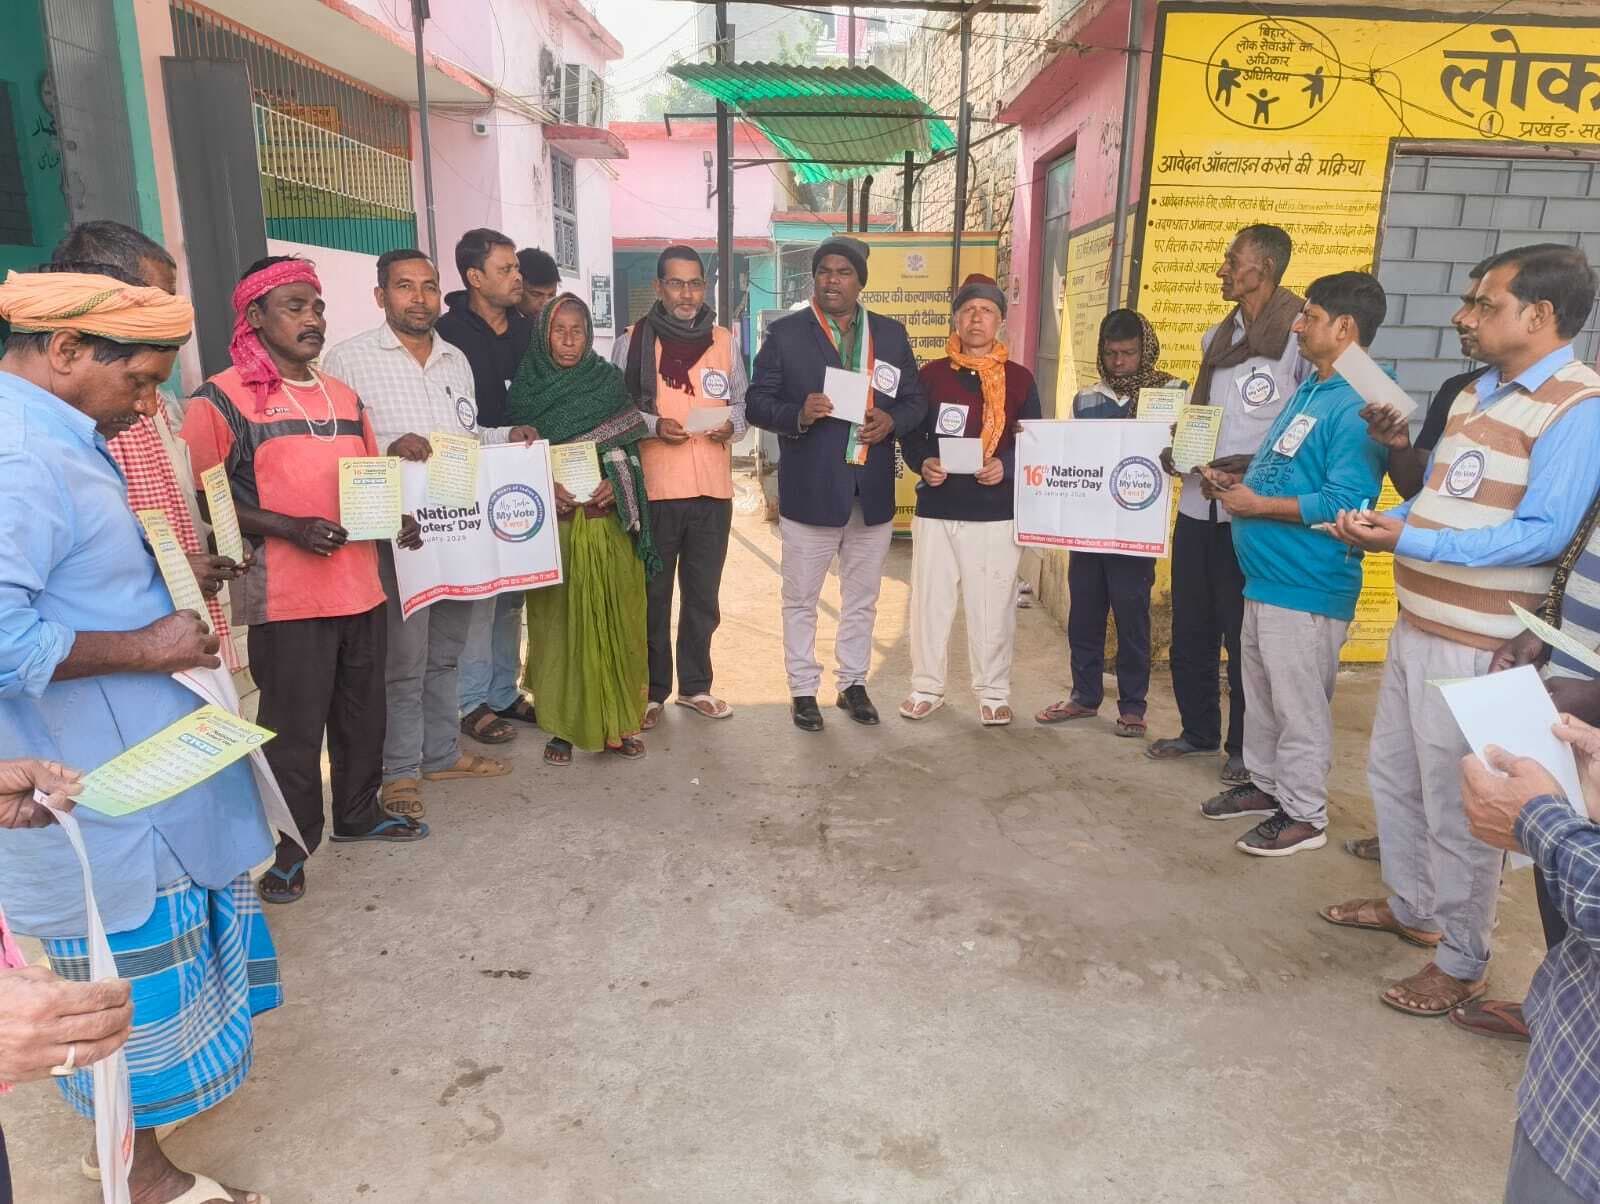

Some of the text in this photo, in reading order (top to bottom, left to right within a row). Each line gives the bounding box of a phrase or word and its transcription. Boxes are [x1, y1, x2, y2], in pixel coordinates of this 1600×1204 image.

[1258, 23, 1288, 38] बिहार
[1236, 37, 1258, 54] लोक
[1259, 38, 1297, 53] सेवाओं
[1246, 52, 1291, 68] अधिकार
[1242, 66, 1290, 82] अधिनियम
[1158, 150, 1366, 177] आवेदन ऑनलाइन करने की प्रक्रिया
[1159, 192, 1184, 210] आवेदन
[861, 286, 952, 304] सरकार की कल्याणकारी
[909, 310, 921, 326] की
[921, 309, 946, 326] दैनिक
[1161, 343, 1195, 351] MS/EMAIL
[1051, 466, 1104, 479] National
[1046, 478, 1102, 491] Voters' Day
[1119, 480, 1152, 489] My Vote
[417, 502, 481, 521] National
[496, 509, 535, 521] My Vote
[418, 519, 481, 534] oters' Day
